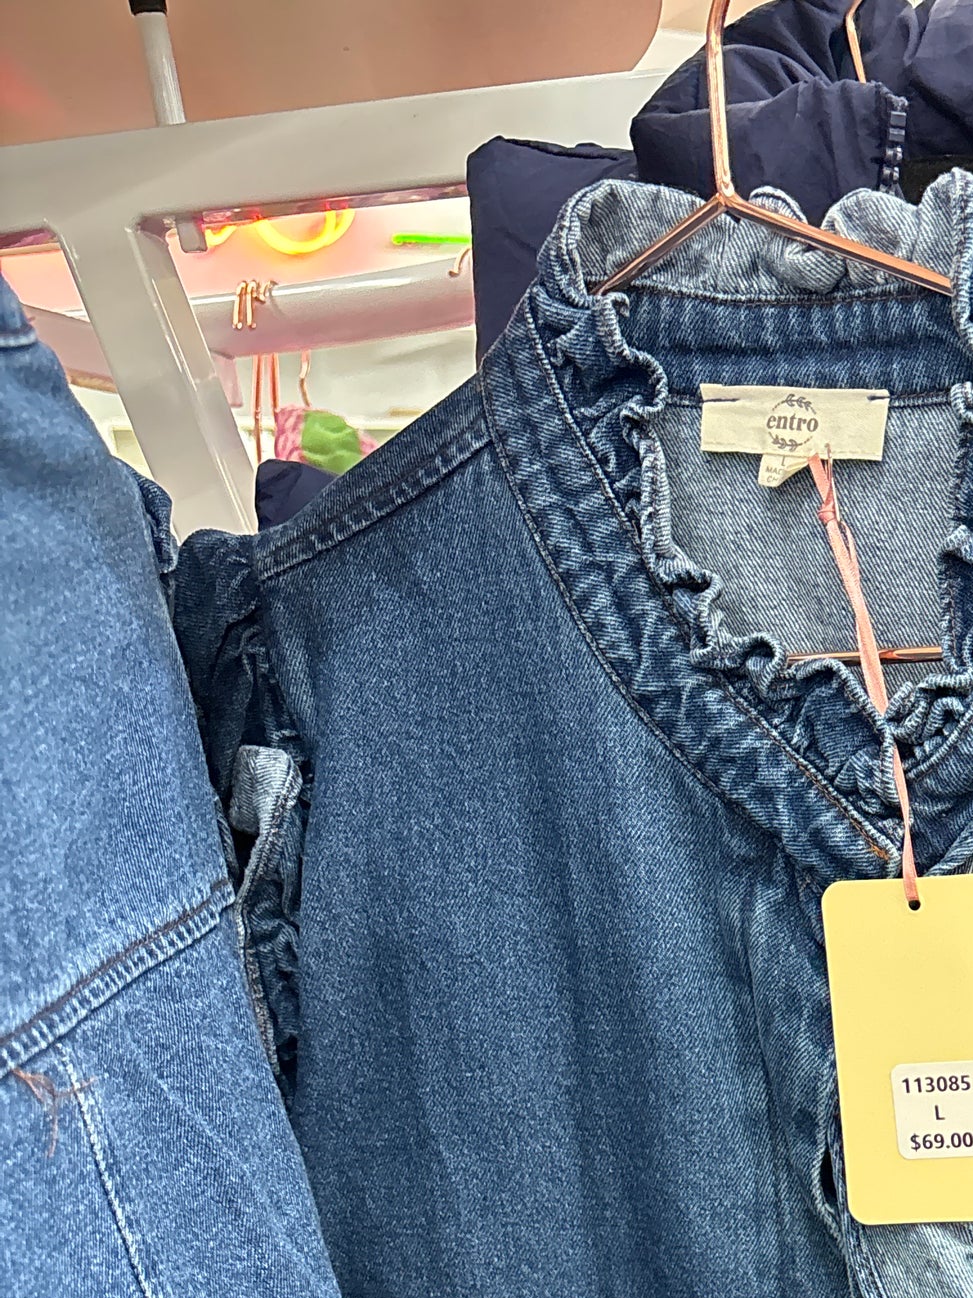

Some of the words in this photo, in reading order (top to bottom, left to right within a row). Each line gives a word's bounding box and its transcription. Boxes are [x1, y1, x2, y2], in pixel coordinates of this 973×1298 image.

[766, 413, 819, 432] entro
[902, 1075, 971, 1093] 113085
[934, 1104, 946, 1120] L
[910, 1132, 973, 1152] $69.00
